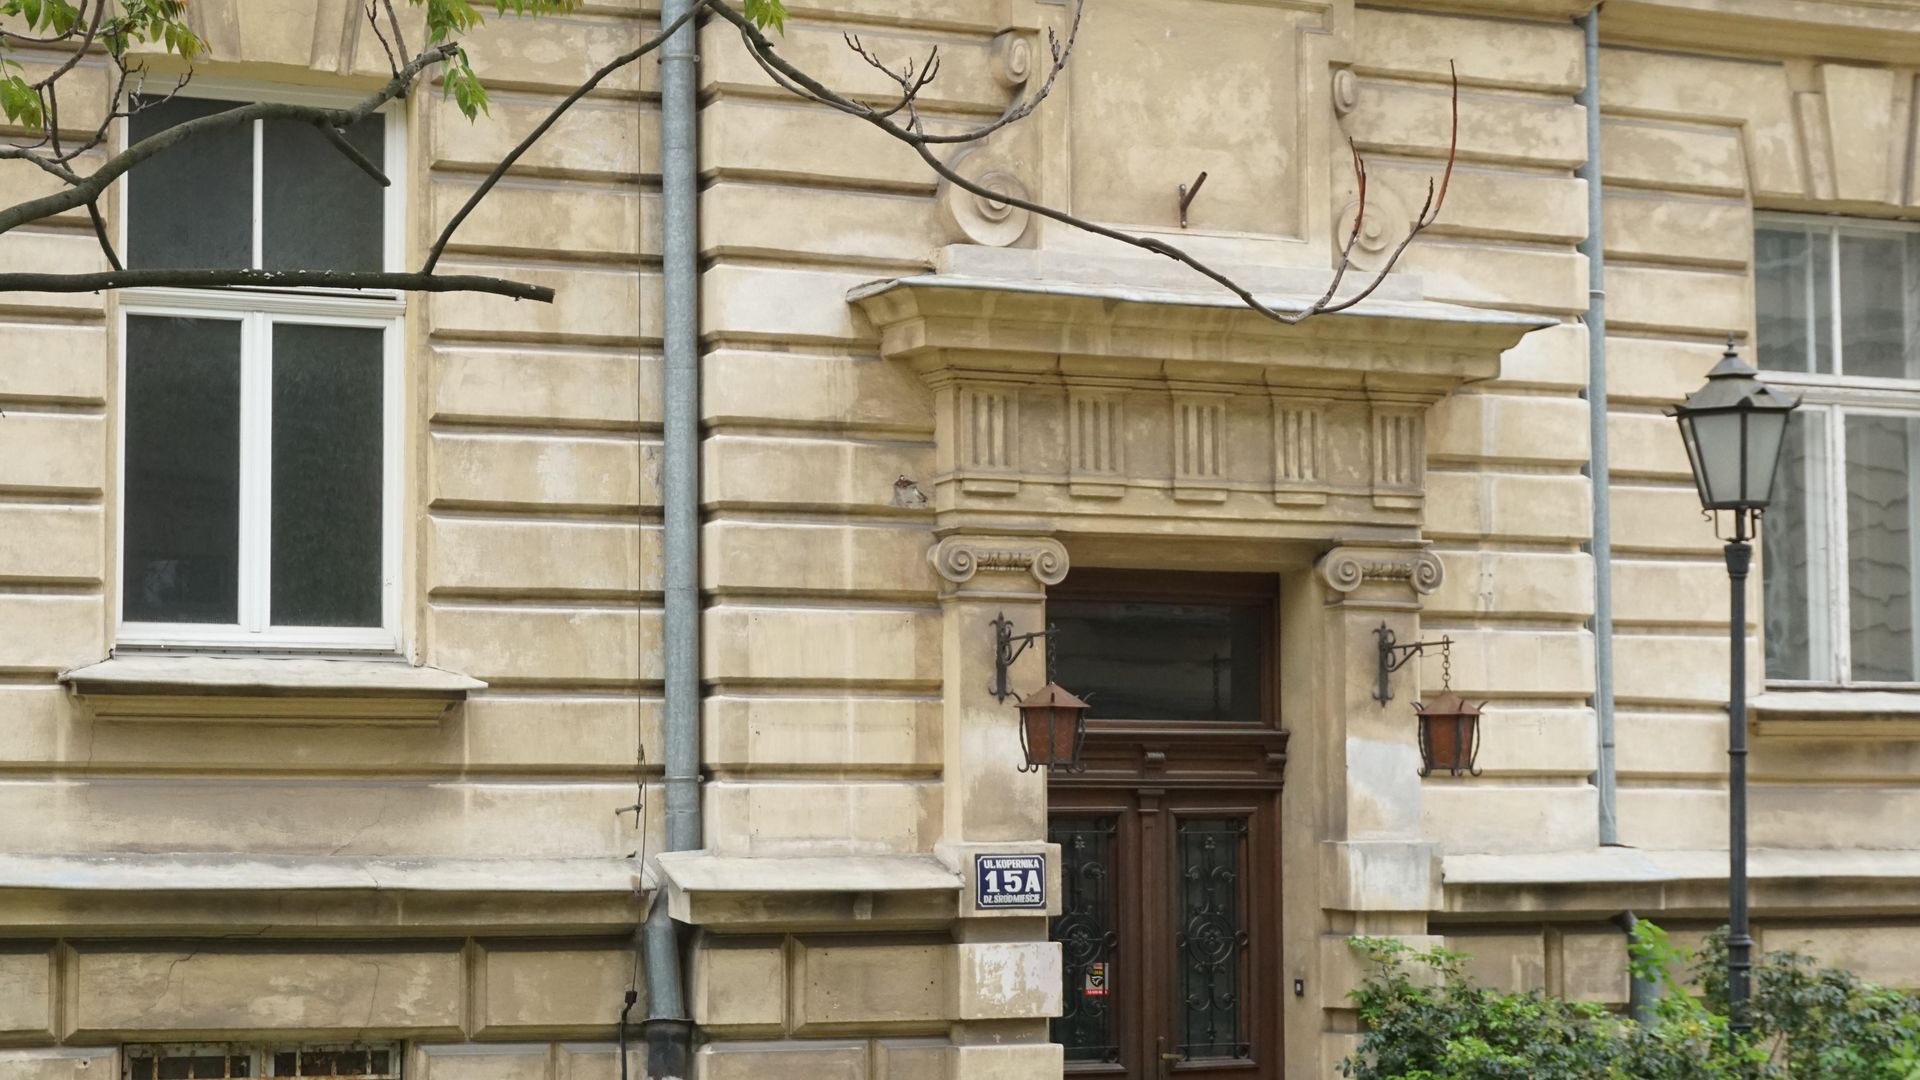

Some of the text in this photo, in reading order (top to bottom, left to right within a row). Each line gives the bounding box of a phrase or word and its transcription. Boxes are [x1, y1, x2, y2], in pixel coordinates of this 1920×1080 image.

[983, 859, 1039, 869] UL. KOPERNIKA
[985, 870, 1041, 893] 15A
